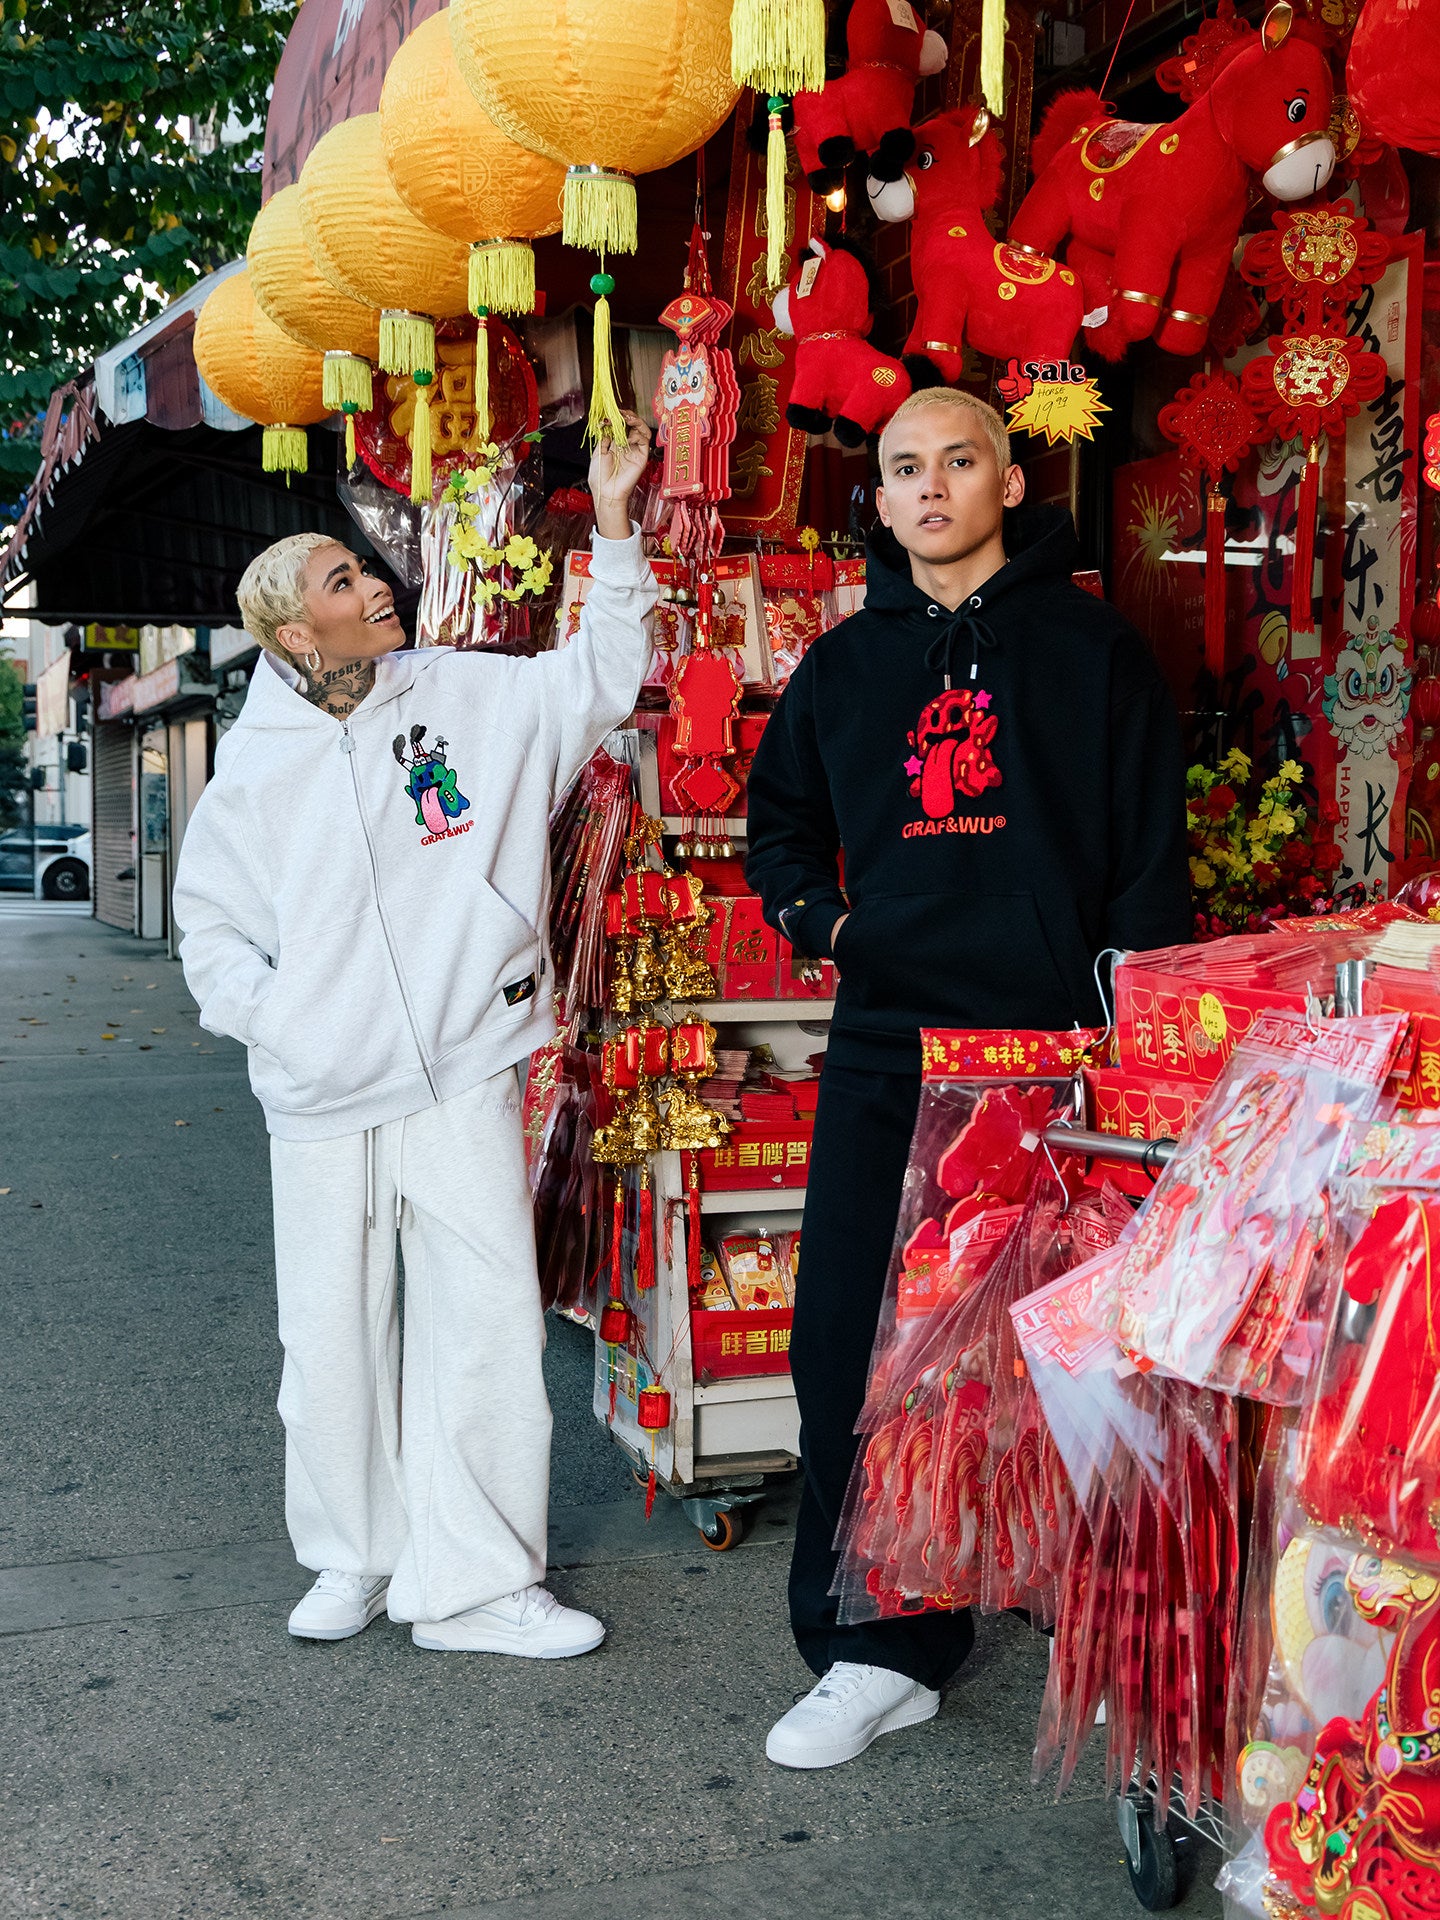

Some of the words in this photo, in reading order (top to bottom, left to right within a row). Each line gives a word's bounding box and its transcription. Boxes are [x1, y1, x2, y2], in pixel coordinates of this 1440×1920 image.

[1024, 360, 1086, 383] sale
[1289, 355, 1329, 395] 安
[674, 406, 691, 482] 五福临门
[322, 660, 362, 685] Jesus
[1337, 766, 1352, 844] HAPPY
